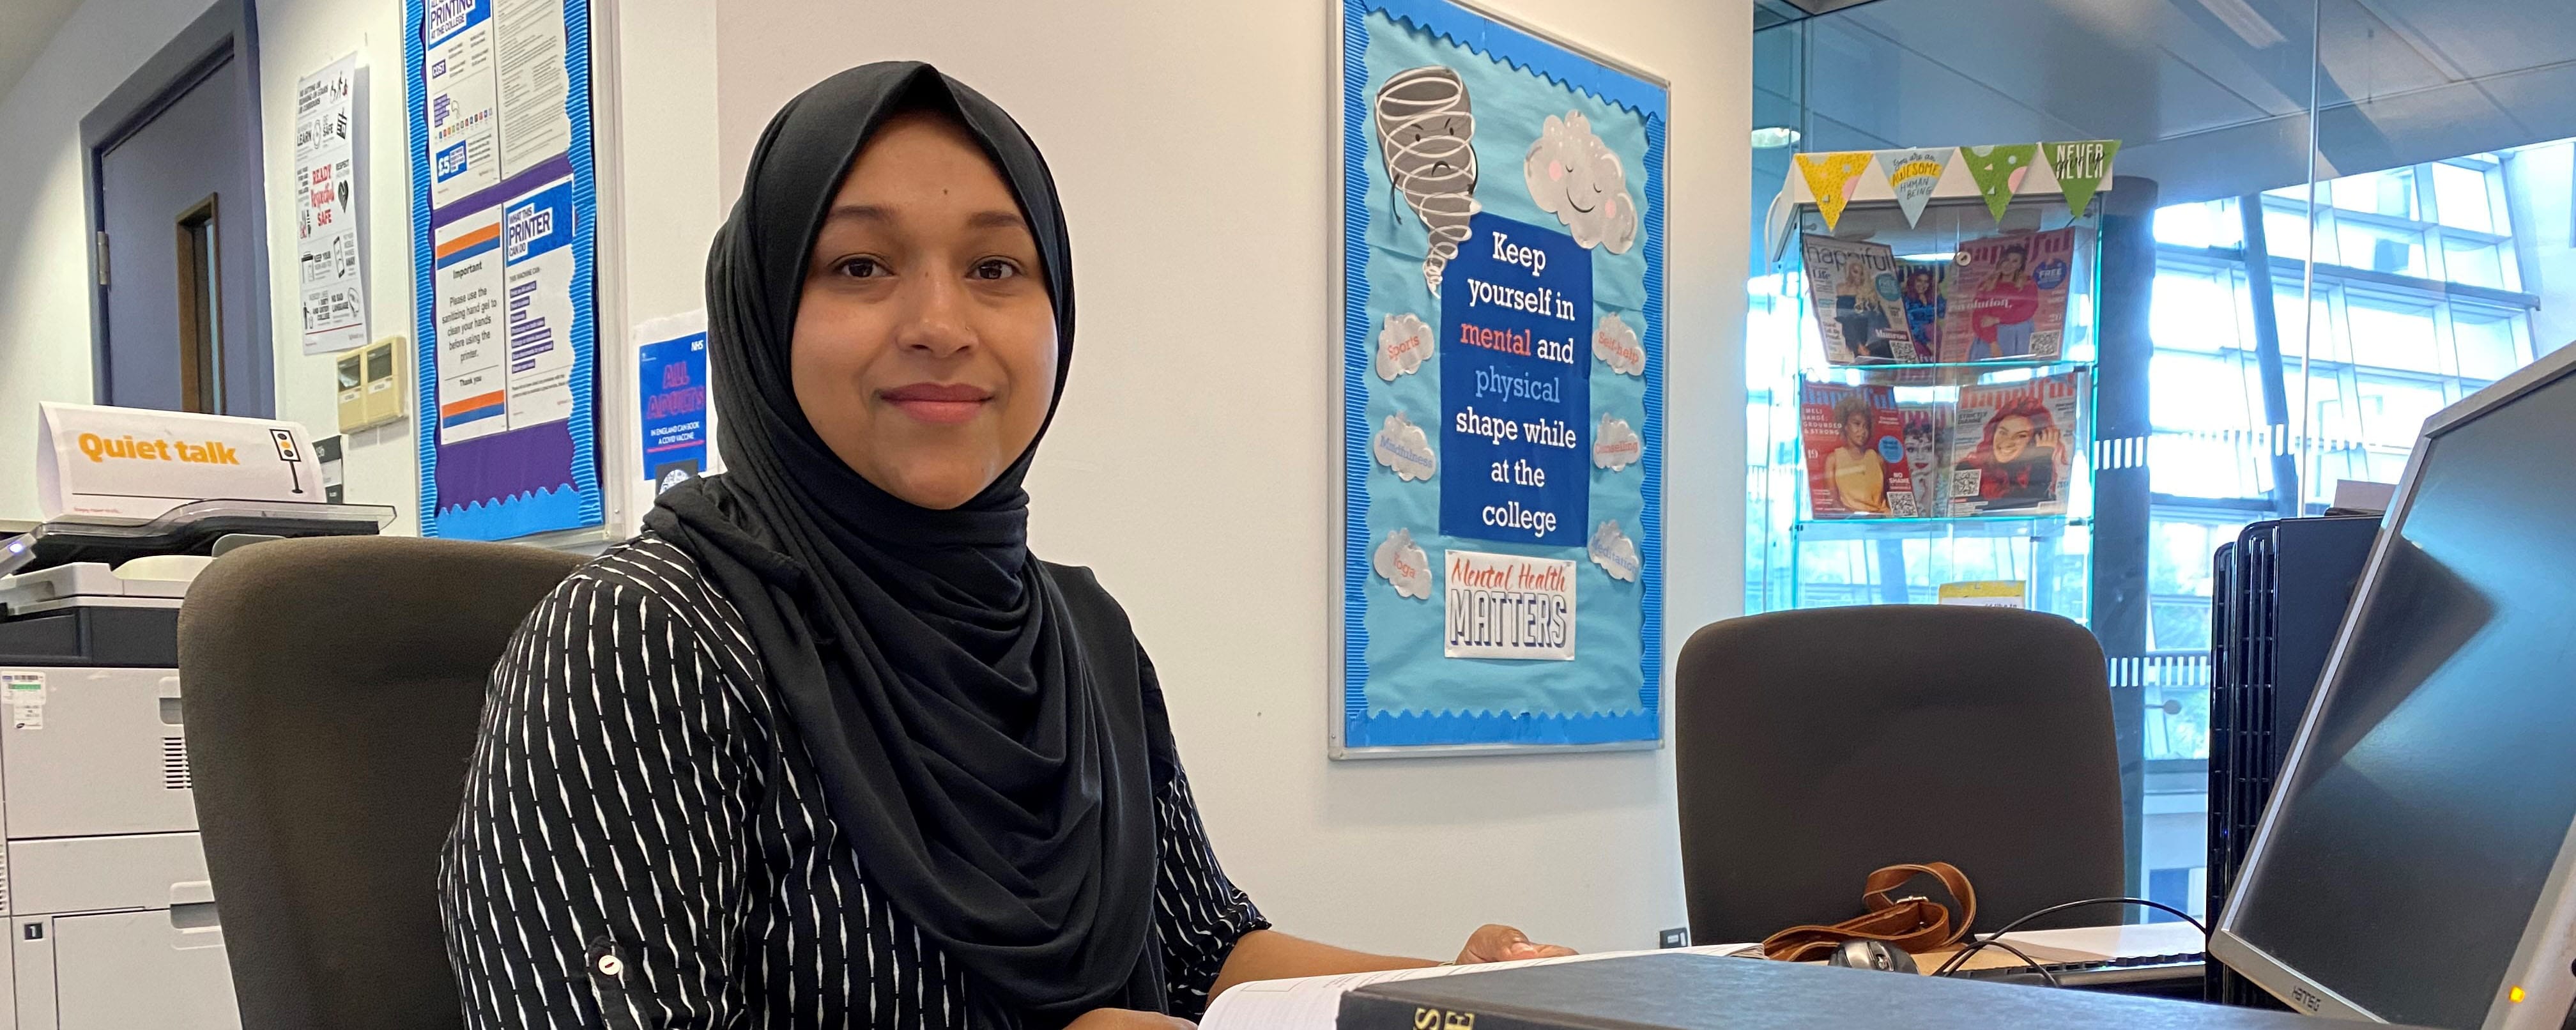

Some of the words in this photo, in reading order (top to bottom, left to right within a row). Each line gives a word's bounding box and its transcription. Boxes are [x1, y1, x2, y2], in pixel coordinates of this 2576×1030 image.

[445, 13, 465, 31] COLLEGE
[298, 130, 312, 146] LEARN
[323, 123, 333, 137] SAFE
[313, 164, 332, 185] READY
[1892, 162, 1940, 187] AWESOME
[1900, 176, 1929, 192] HUMAN
[1906, 187, 1932, 199] BEING
[318, 208, 332, 226] SAFE
[509, 211, 551, 247] PRINTER
[509, 245, 519, 257] CAN
[1492, 231, 1546, 276] Keep
[453, 261, 482, 279] Important
[2039, 267, 2062, 278] FREE
[450, 295, 466, 307] Please
[467, 291, 477, 300] use
[478, 288, 487, 297] the
[466, 302, 479, 315] hand
[1468, 278, 1551, 315] yourself
[1556, 291, 1575, 321] in
[448, 325, 461, 336] clean
[461, 321, 473, 335] your
[474, 314, 491, 327] hands
[449, 339, 464, 350] before
[466, 334, 480, 344] using
[481, 330, 490, 340] the
[691, 340, 704, 351] NHS
[1388, 336, 1420, 360] Sports
[1460, 321, 1531, 357] mental
[1537, 337, 1574, 364] and
[1598, 331, 1639, 364] Self-help
[663, 360, 690, 389] ALL
[1475, 366, 1560, 404] physical
[647, 385, 706, 419] ADULTS
[1455, 407, 1518, 445] shape
[1522, 422, 1577, 449] while
[78, 433, 171, 463] Quiet
[173, 440, 240, 465] talk
[1491, 461, 1510, 484] at
[1514, 461, 1545, 487] the
[1482, 502, 1556, 538] college
[1451, 557, 1514, 592] Mental
[1518, 563, 1566, 592] Health
[1450, 589, 1567, 649] MATTERS
[30, 926, 36, 937] 1
